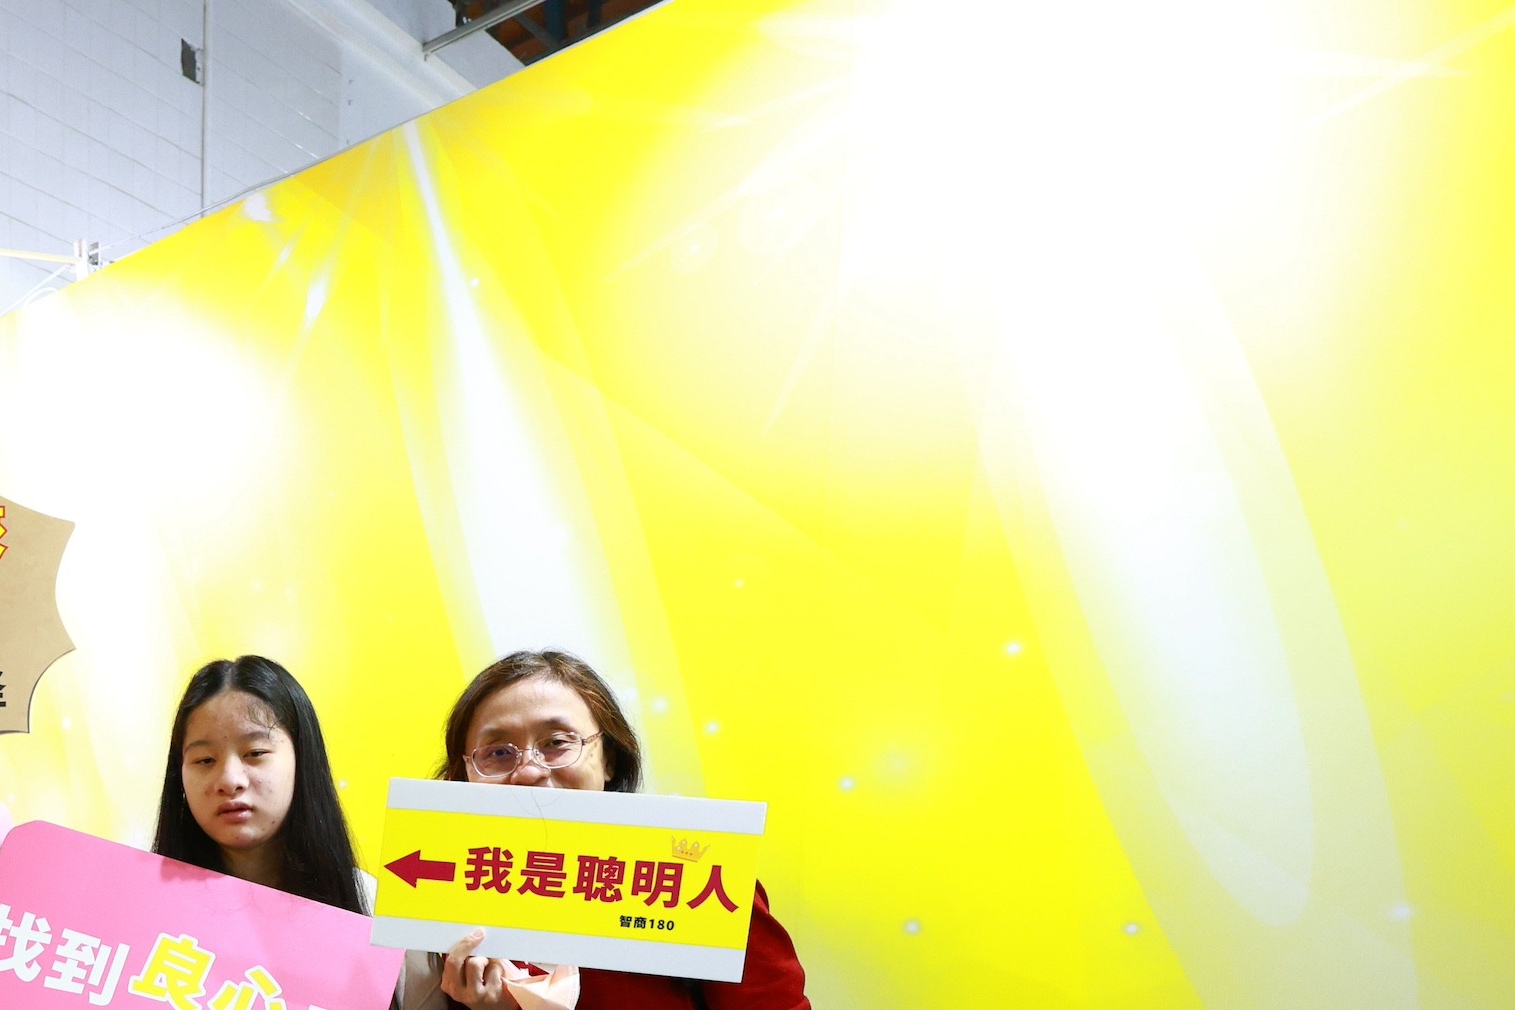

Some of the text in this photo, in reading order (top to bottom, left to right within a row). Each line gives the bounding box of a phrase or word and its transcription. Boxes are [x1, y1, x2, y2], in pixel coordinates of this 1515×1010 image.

[463, 845, 740, 913] 我是聰明人
